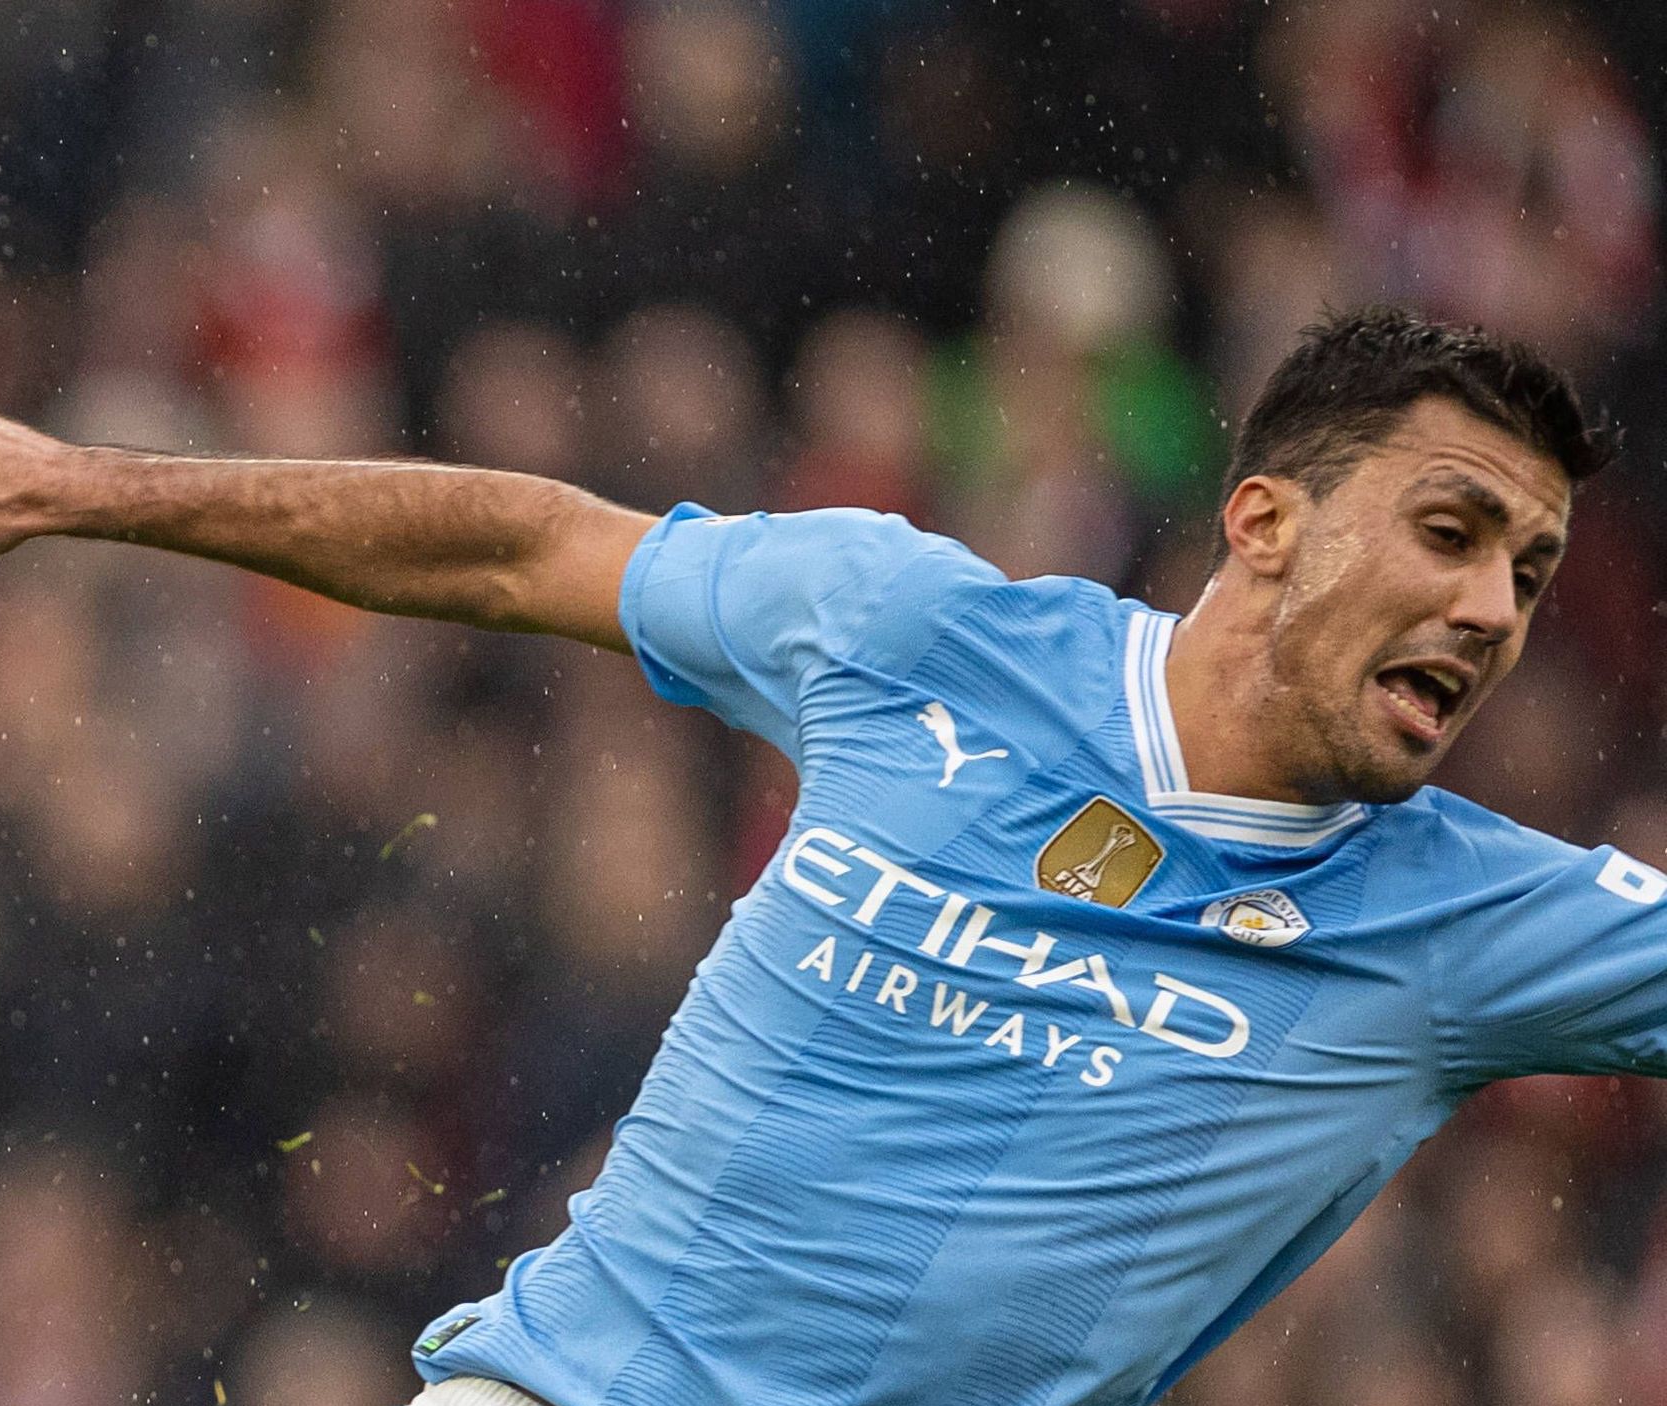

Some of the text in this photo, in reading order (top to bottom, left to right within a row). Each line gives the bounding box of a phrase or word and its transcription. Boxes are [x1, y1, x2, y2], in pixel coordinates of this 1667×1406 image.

[782, 826, 1251, 1059] ETIHAD
[796, 935, 1124, 1088] AIRWAYS
[1231, 926, 1267, 944] CITY
